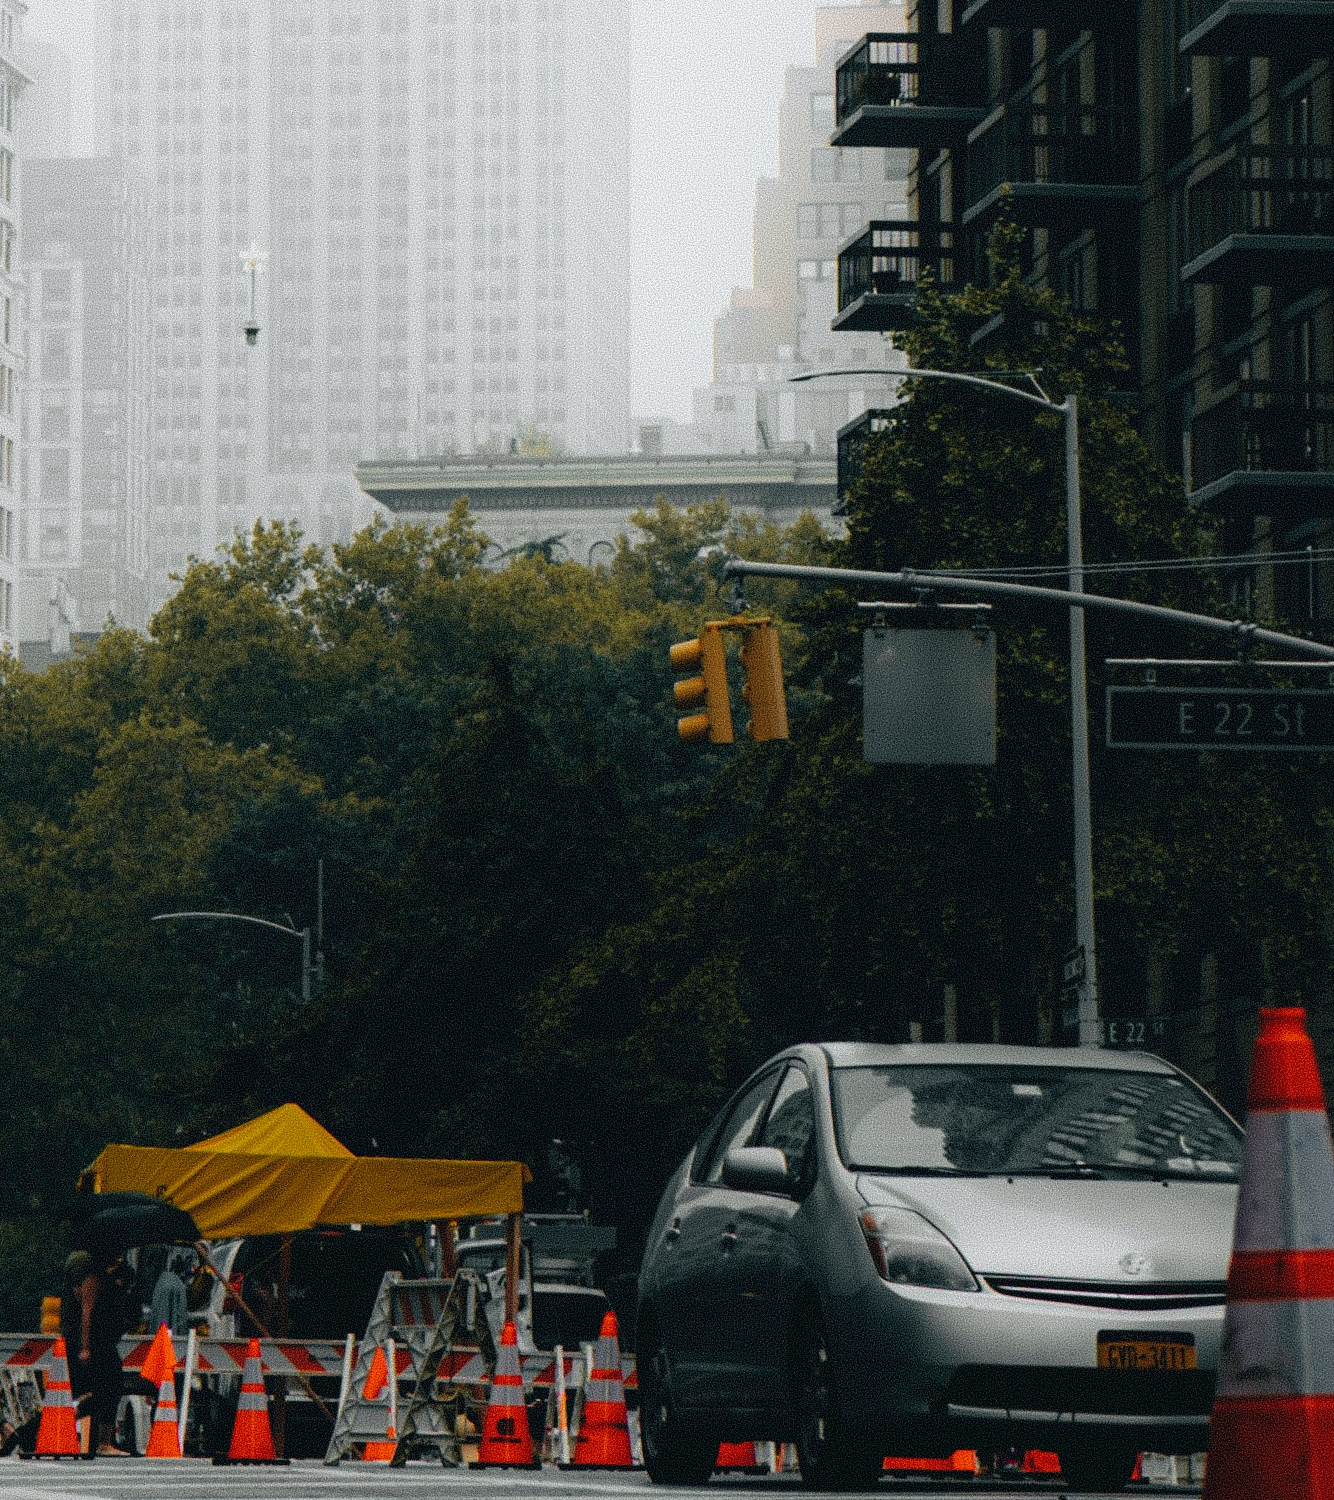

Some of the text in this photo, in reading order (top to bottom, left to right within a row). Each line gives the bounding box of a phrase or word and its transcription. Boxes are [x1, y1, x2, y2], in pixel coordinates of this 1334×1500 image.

[1179, 702, 1306, 737] E 22 St
[1109, 1022, 1118, 1043] E
[1126, 1022, 1145, 1043] 22
